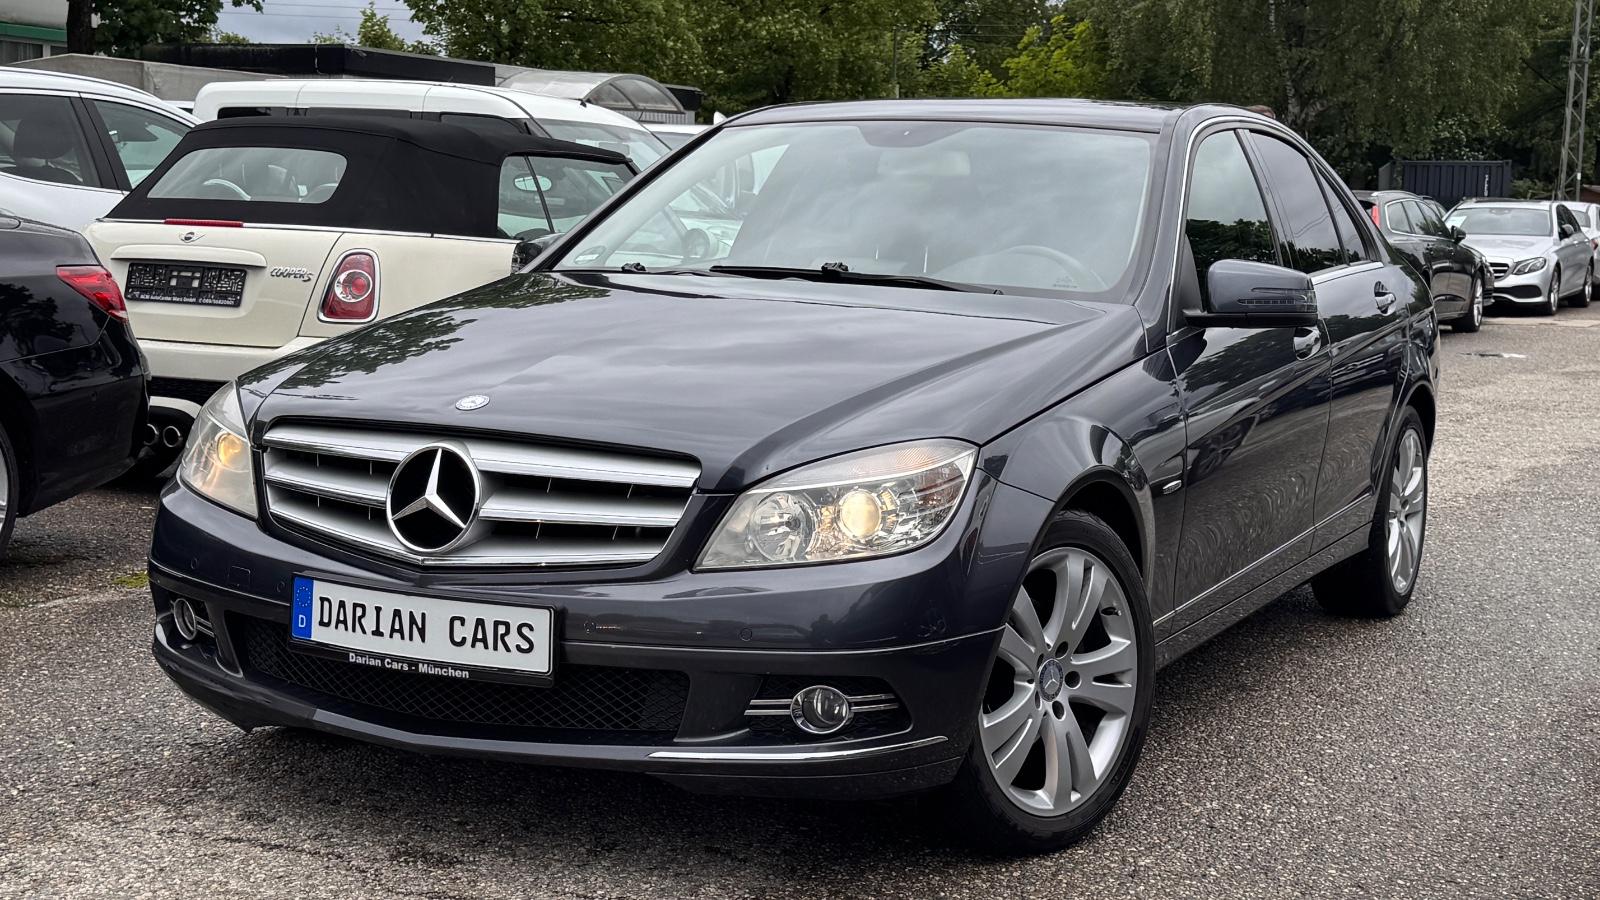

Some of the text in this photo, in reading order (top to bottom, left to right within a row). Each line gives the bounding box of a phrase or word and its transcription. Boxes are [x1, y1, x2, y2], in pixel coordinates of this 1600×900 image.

[270, 267, 314, 282] COOPER S
[298, 614, 306, 628] D
[318, 596, 535, 654] DARIAN CARS
[348, 652, 381, 667] Darian
[384, 658, 408, 671] Cars
[418, 662, 469, 679] München
